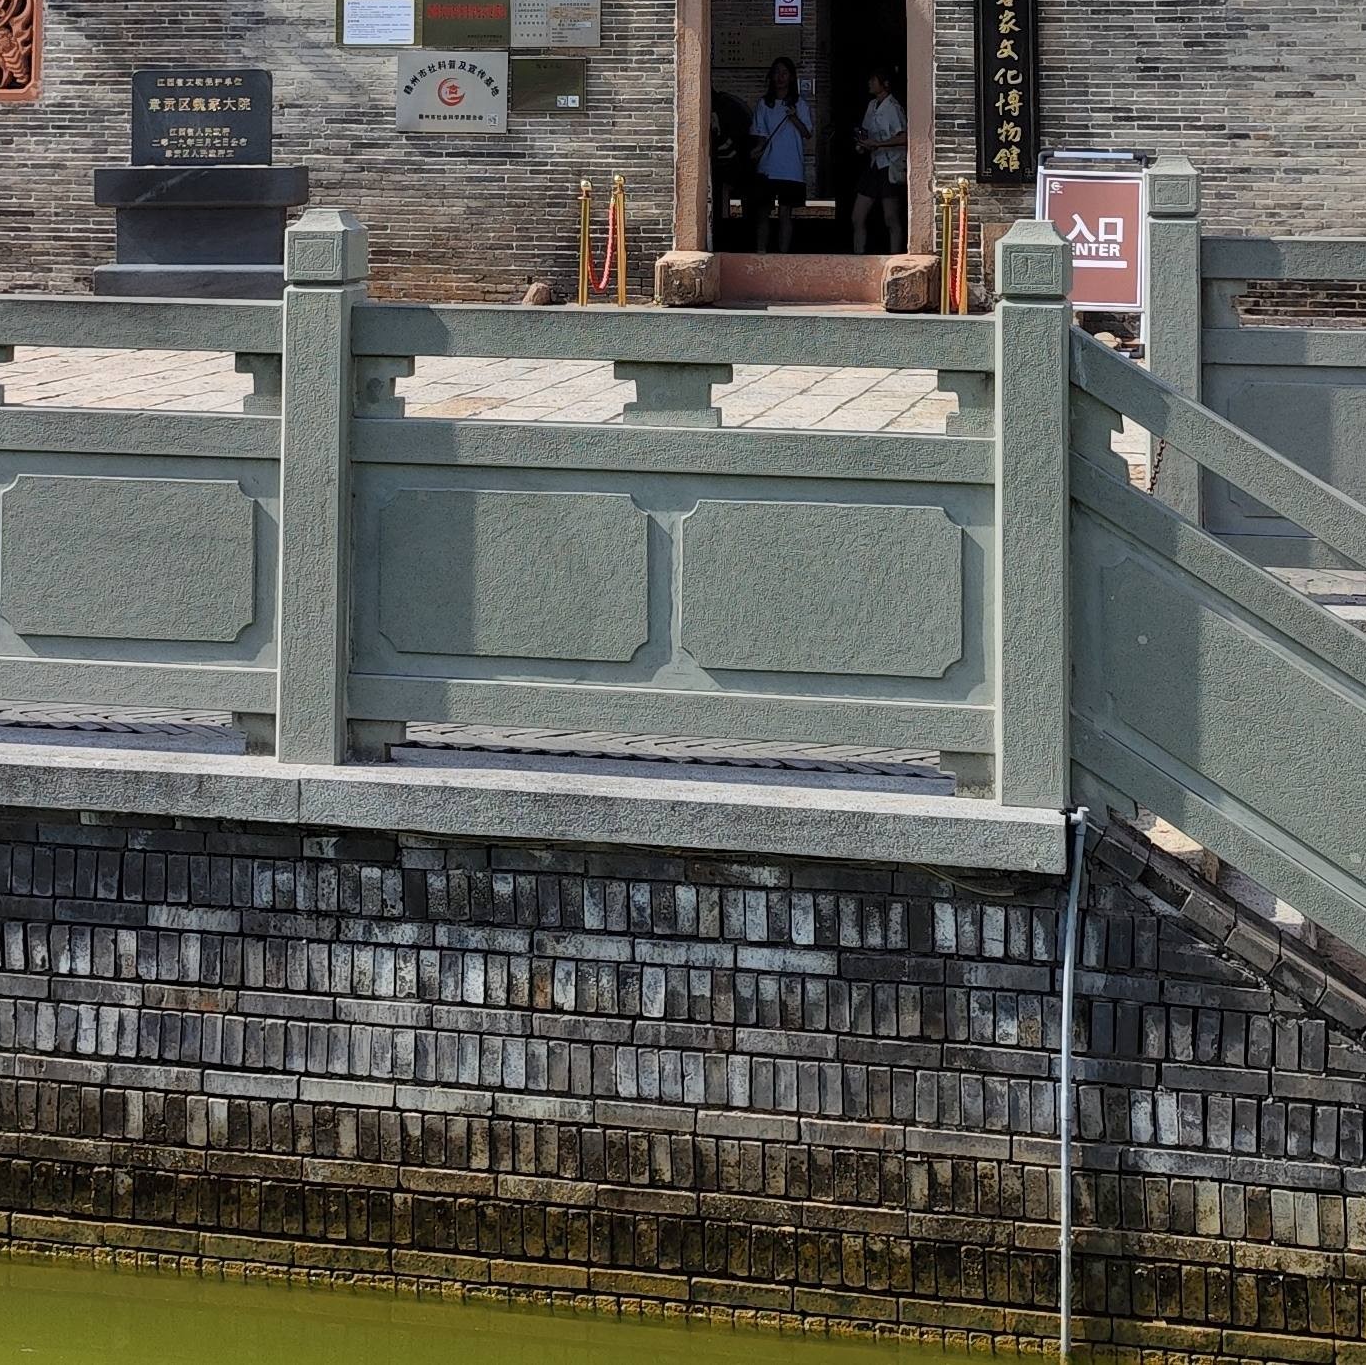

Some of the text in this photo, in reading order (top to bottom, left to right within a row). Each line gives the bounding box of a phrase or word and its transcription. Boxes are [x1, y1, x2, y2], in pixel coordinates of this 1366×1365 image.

[156, 77, 243, 87] 江西省文物保护单位
[403, 59, 500, 97] 赣州市社科普及宣传基地
[148, 97, 252, 112] 章贡区魏家大院
[169, 128, 231, 137] 江西省人民政府
[1066, 213, 1124, 243] 入口
